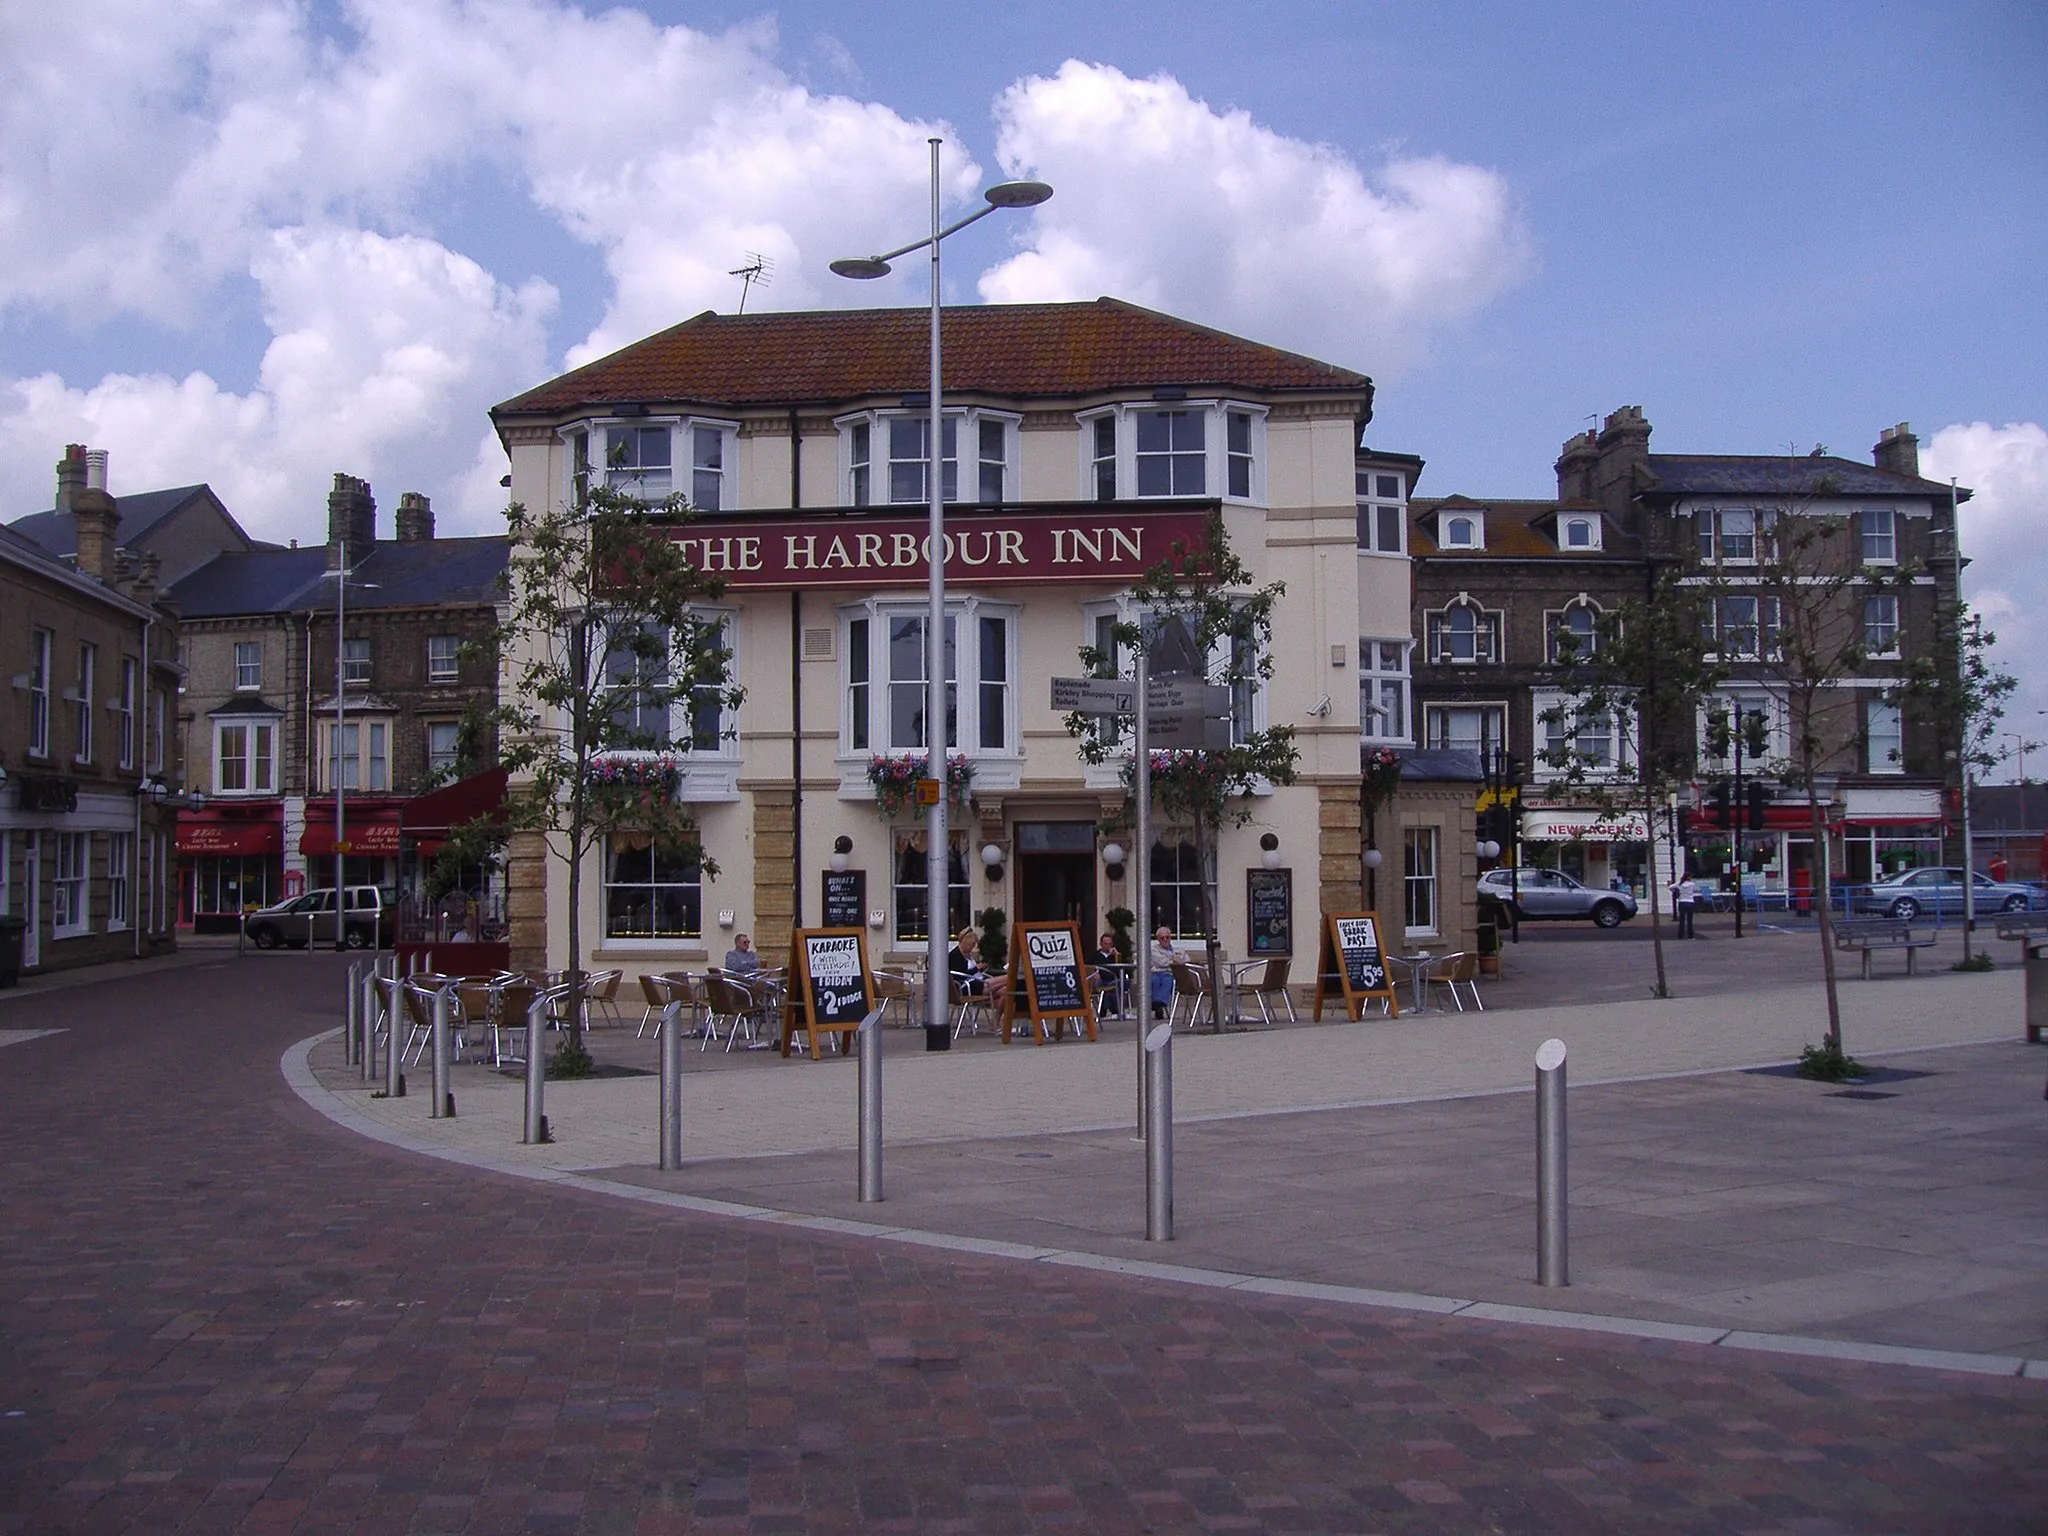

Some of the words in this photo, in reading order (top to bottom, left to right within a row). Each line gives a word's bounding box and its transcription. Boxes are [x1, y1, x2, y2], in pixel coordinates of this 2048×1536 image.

[671, 536, 764, 572] THE
[783, 530, 1030, 570] HARBOUR
[1050, 527, 1145, 564] INN
[1054, 679, 1091, 689] Esplanade
[1054, 689, 1080, 699] Kirkley
[1081, 690, 1115, 700] Shopping
[1055, 697, 1079, 706] Toilets
[811, 939, 856, 955] KARAOKE
[1029, 935, 1068, 960] Quiz
[818, 976, 853, 987] FRIDAY
[1065, 971, 1076, 988] 8
